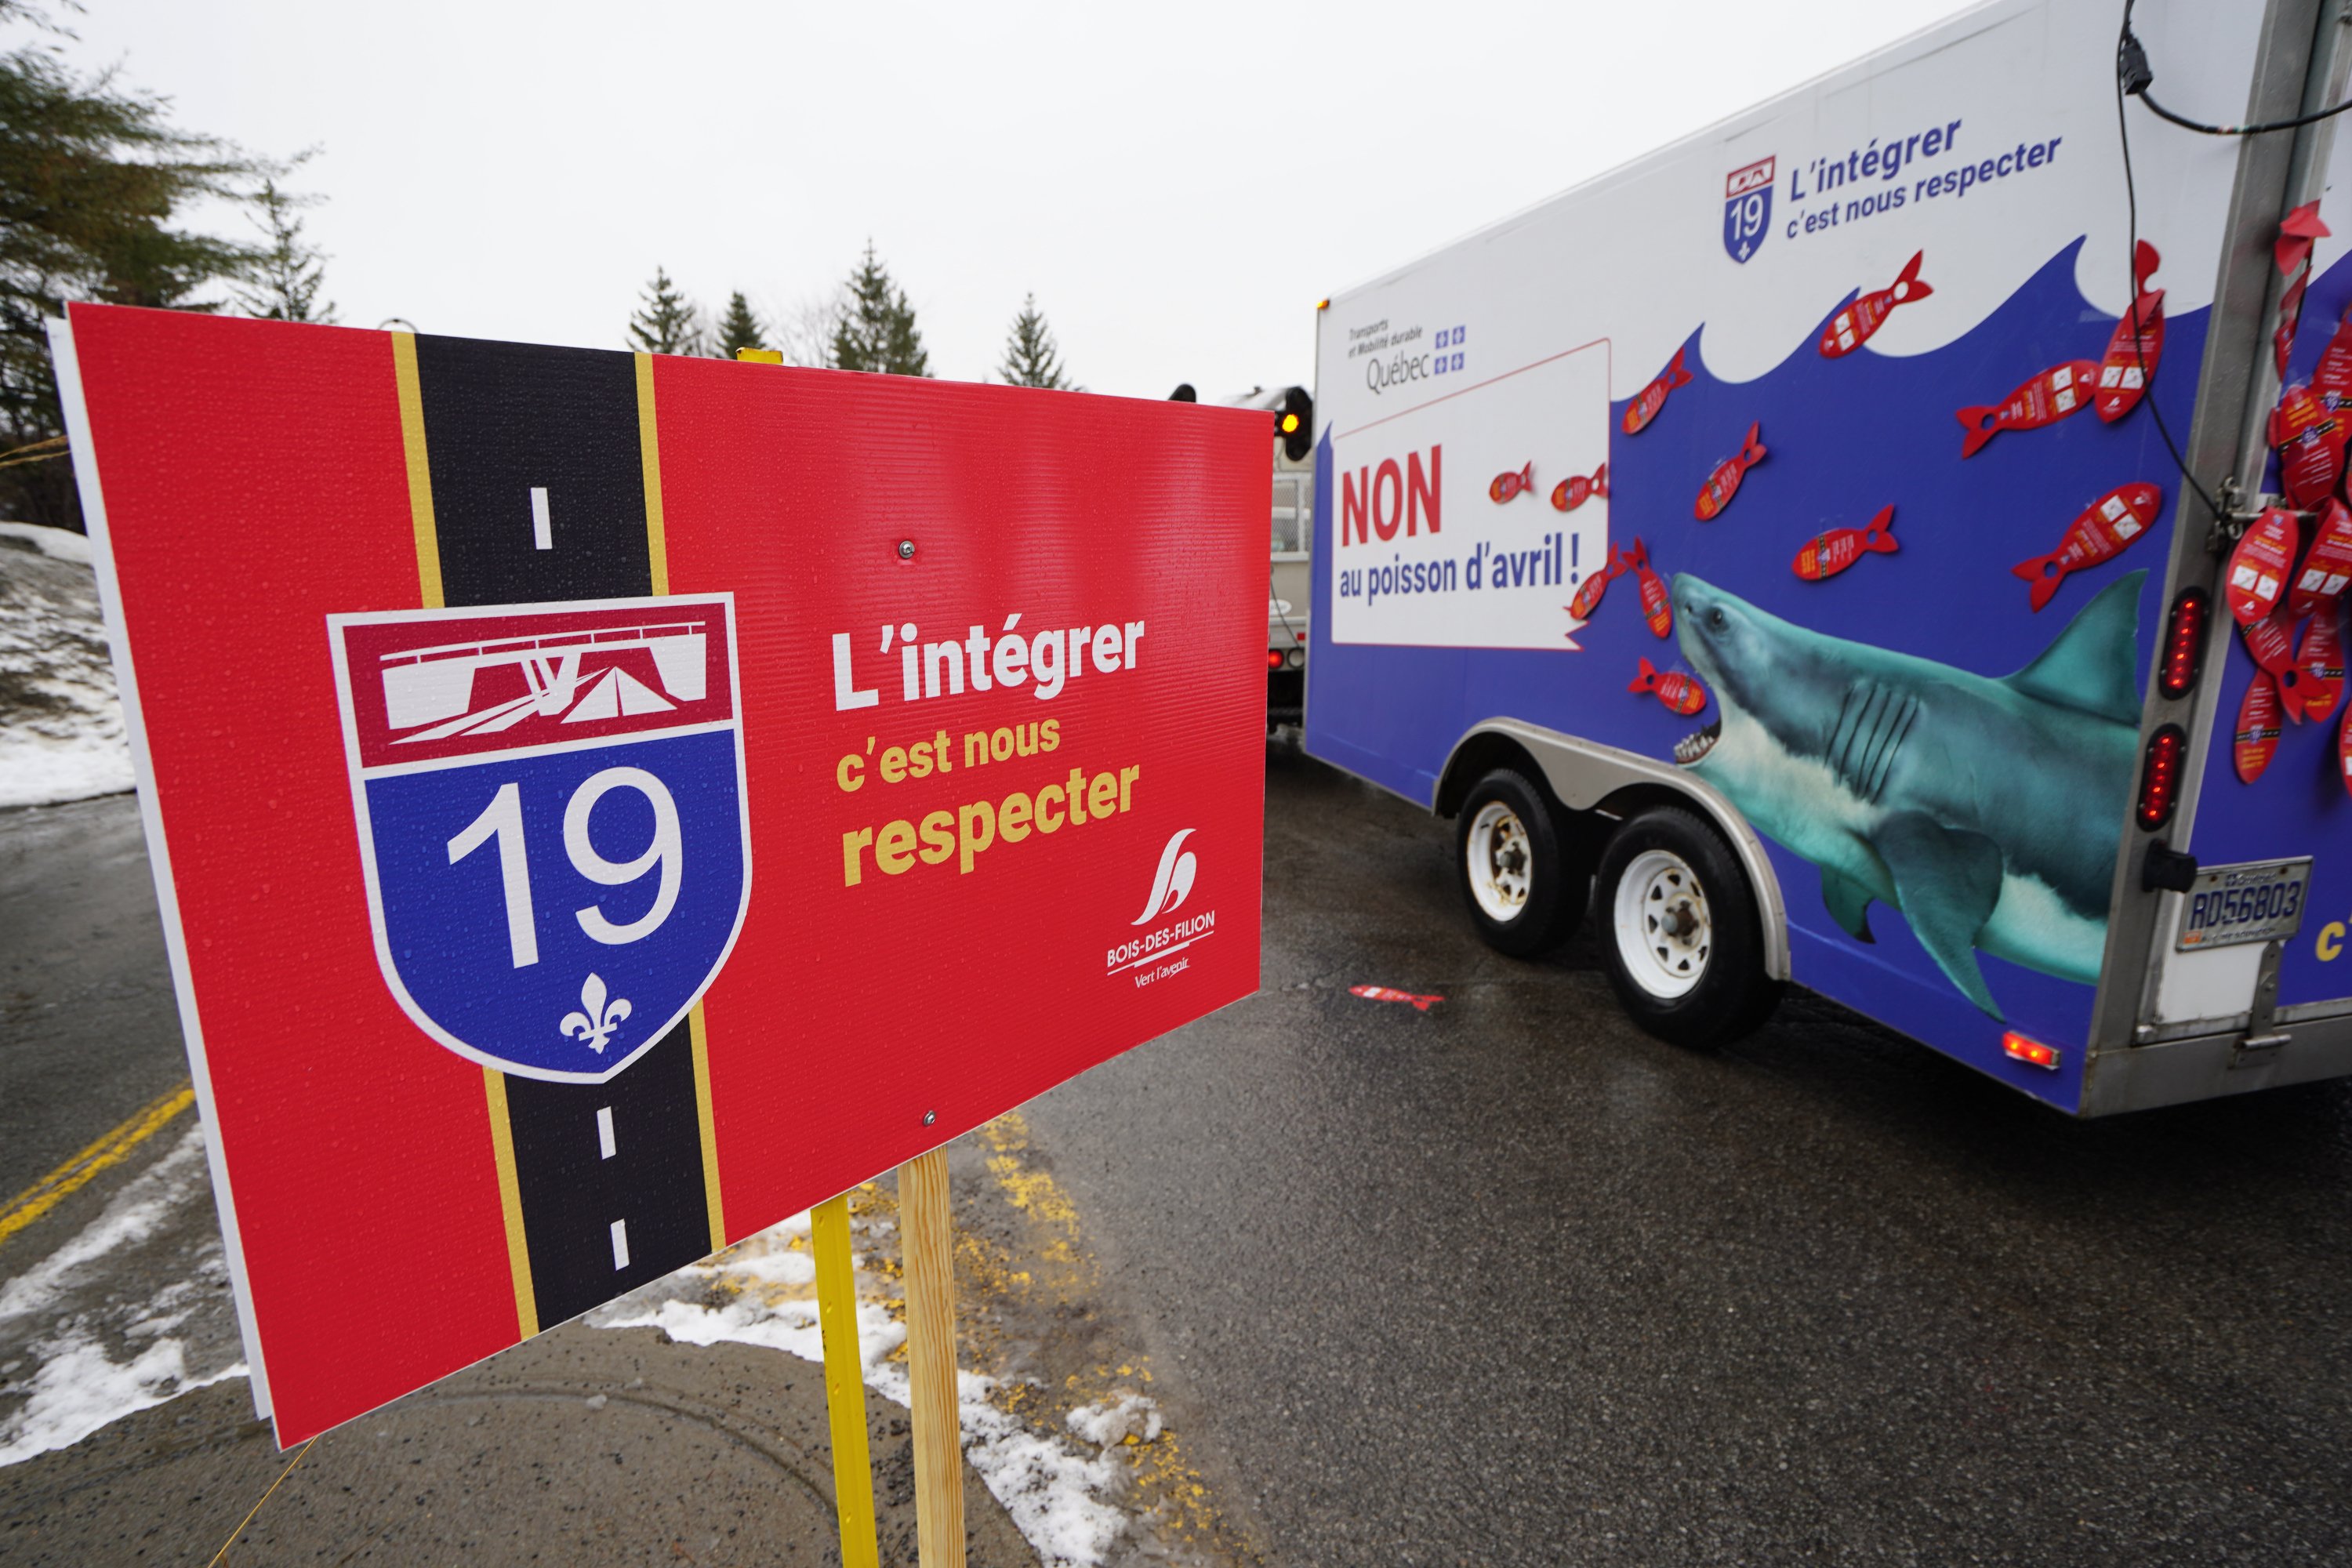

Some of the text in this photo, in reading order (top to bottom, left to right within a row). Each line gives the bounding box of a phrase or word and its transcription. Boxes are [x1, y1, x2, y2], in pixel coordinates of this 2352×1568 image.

[1787, 136, 2063, 239] c'est nous respecter
[1791, 118, 1962, 202] L'intégrer
[1730, 194, 1764, 241] 19
[1391, 325, 1423, 346] durable
[1367, 350, 1429, 394] Québec
[1341, 444, 1442, 547] NON
[1340, 568, 1362, 598] au
[1368, 554, 1457, 606] poisson
[832, 613, 1145, 711] L'intégrer
[837, 719, 1061, 792] c'est nous
[842, 764, 1140, 887] respecter
[447, 767, 682, 969] 19
[2189, 880, 2302, 931] RD56803
[1107, 910, 1215, 967] BOIS-DES-FILION
[1134, 957, 1189, 988] Vert l'avenir
